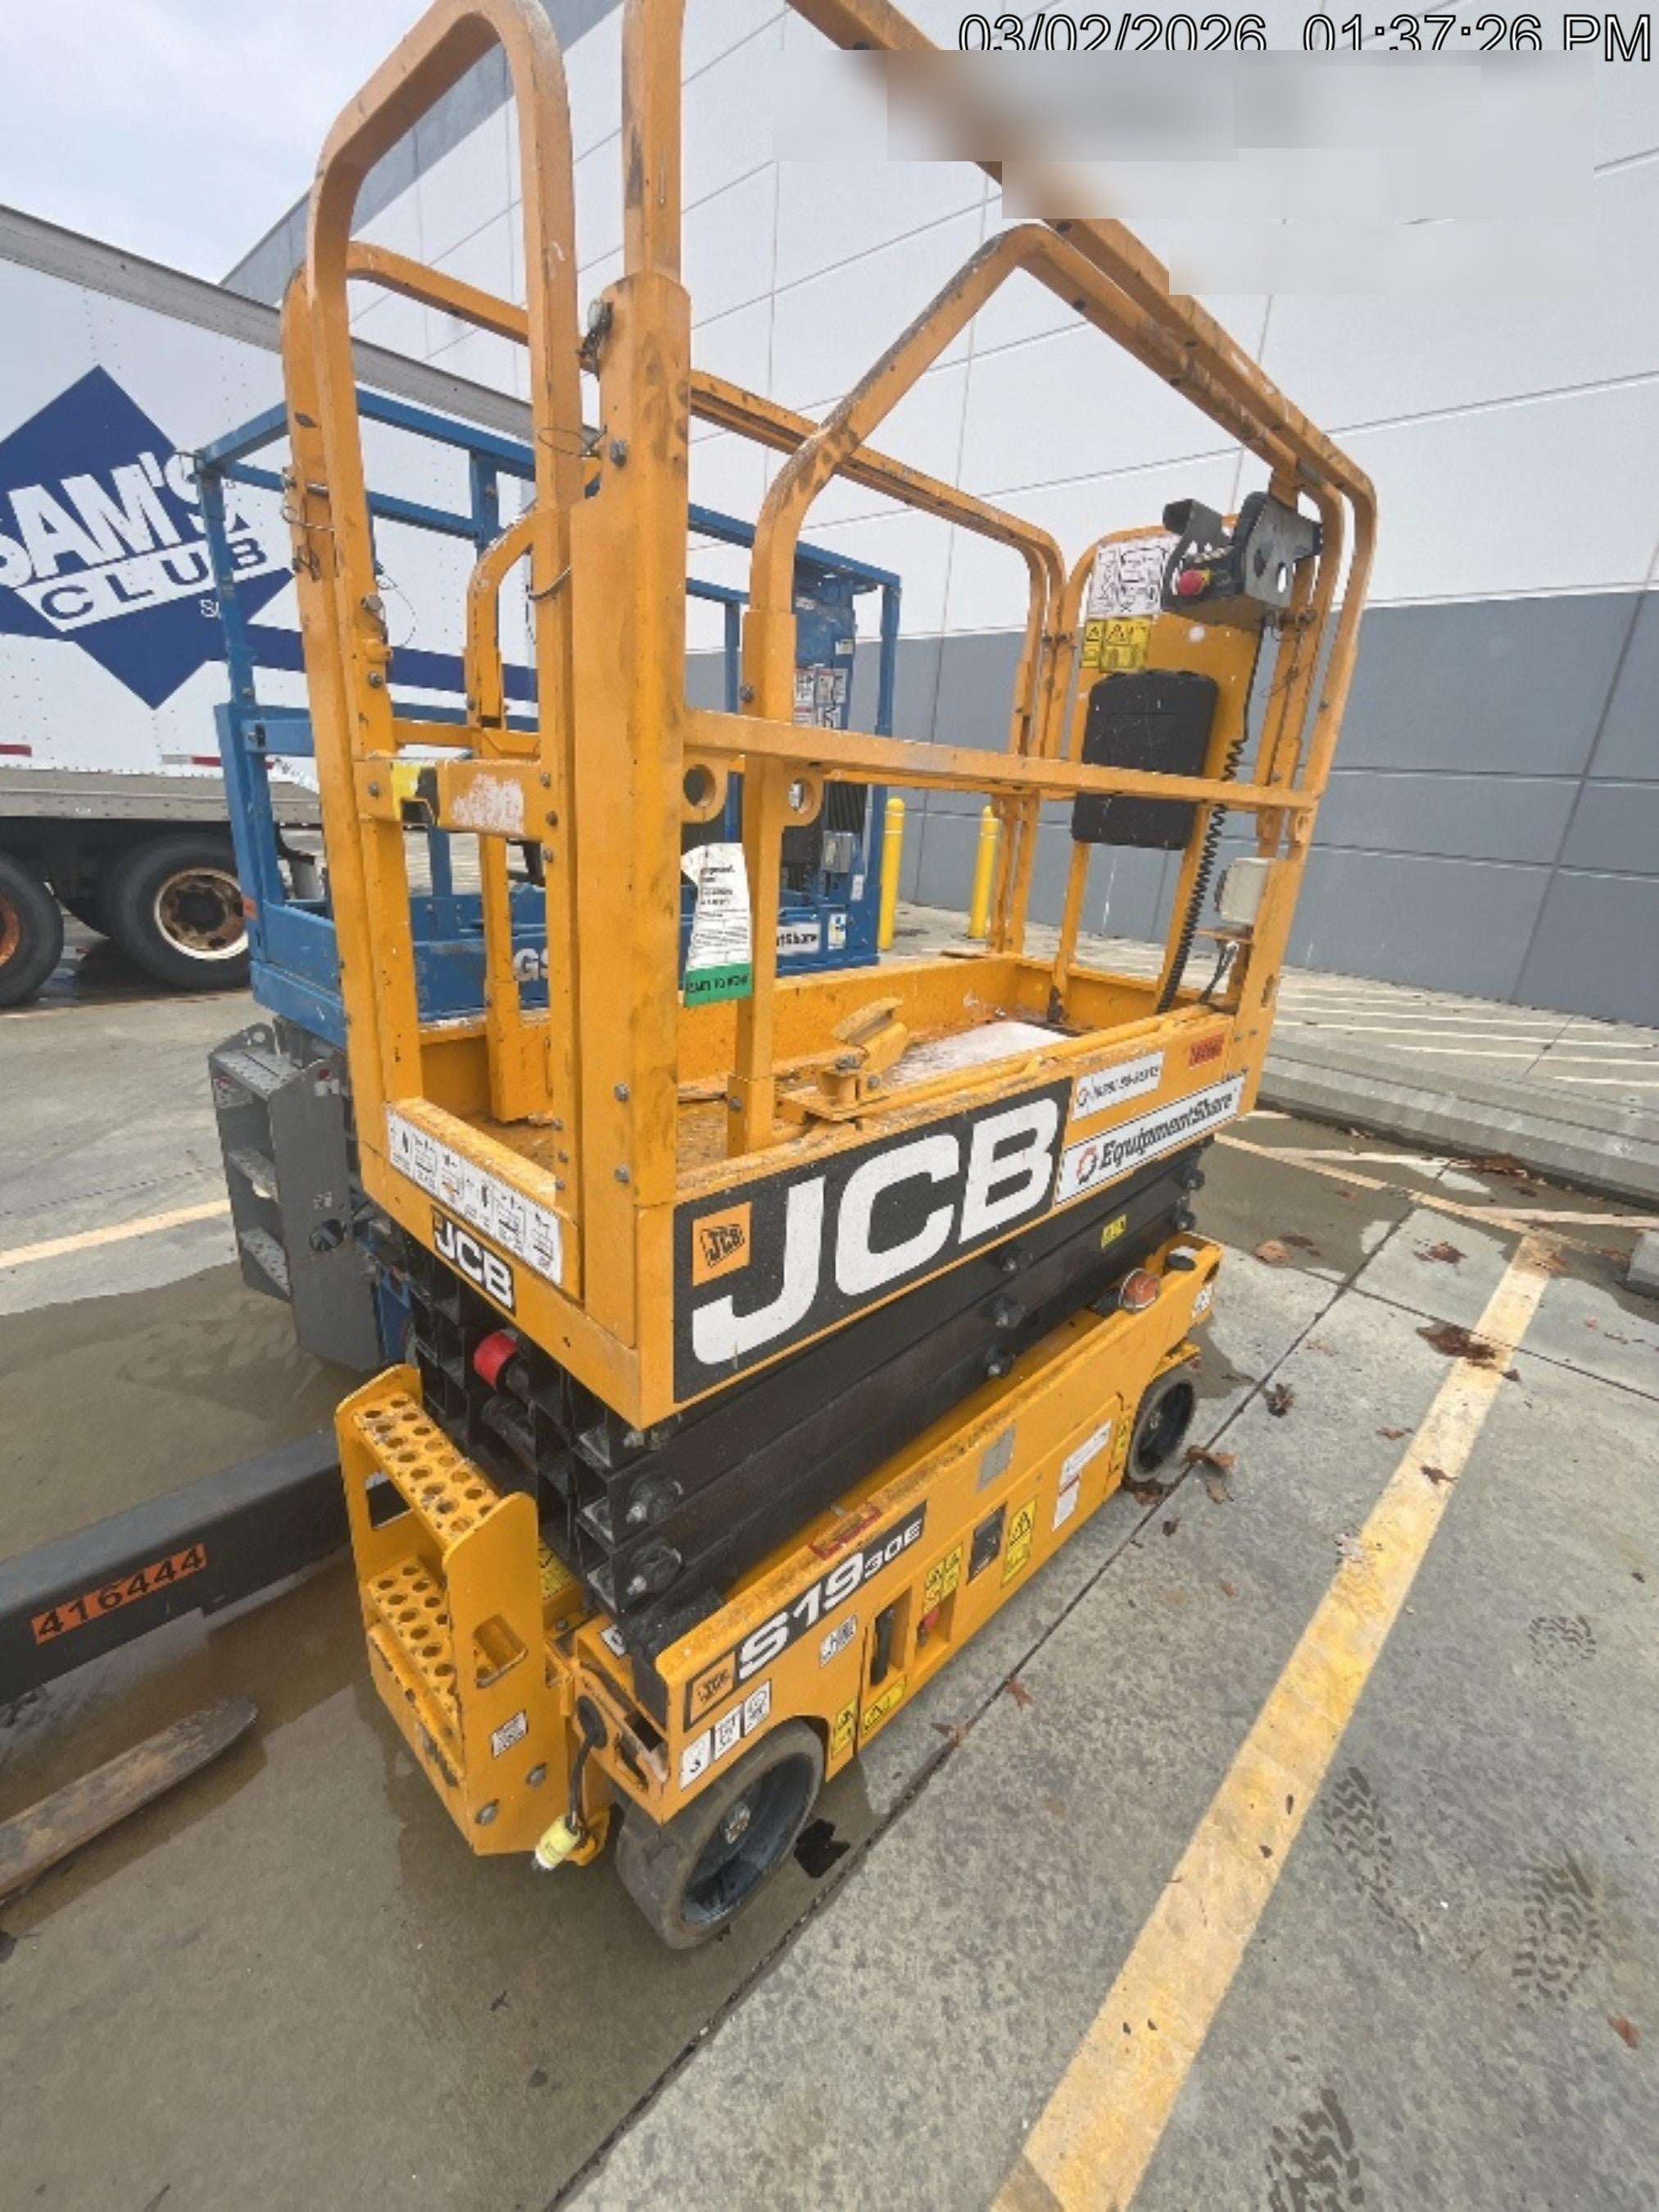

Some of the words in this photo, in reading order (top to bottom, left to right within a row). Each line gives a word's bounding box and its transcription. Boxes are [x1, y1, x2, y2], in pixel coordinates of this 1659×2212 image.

[41, 537, 267, 619] CLUB
[1099, 1093, 1232, 1169] EquipmentShare
[434, 1220, 513, 1309] JCB
[692, 1098, 1058, 1365] JCB
[703, 1226, 744, 1266] JCB
[39, 1547, 203, 1638] 416444
